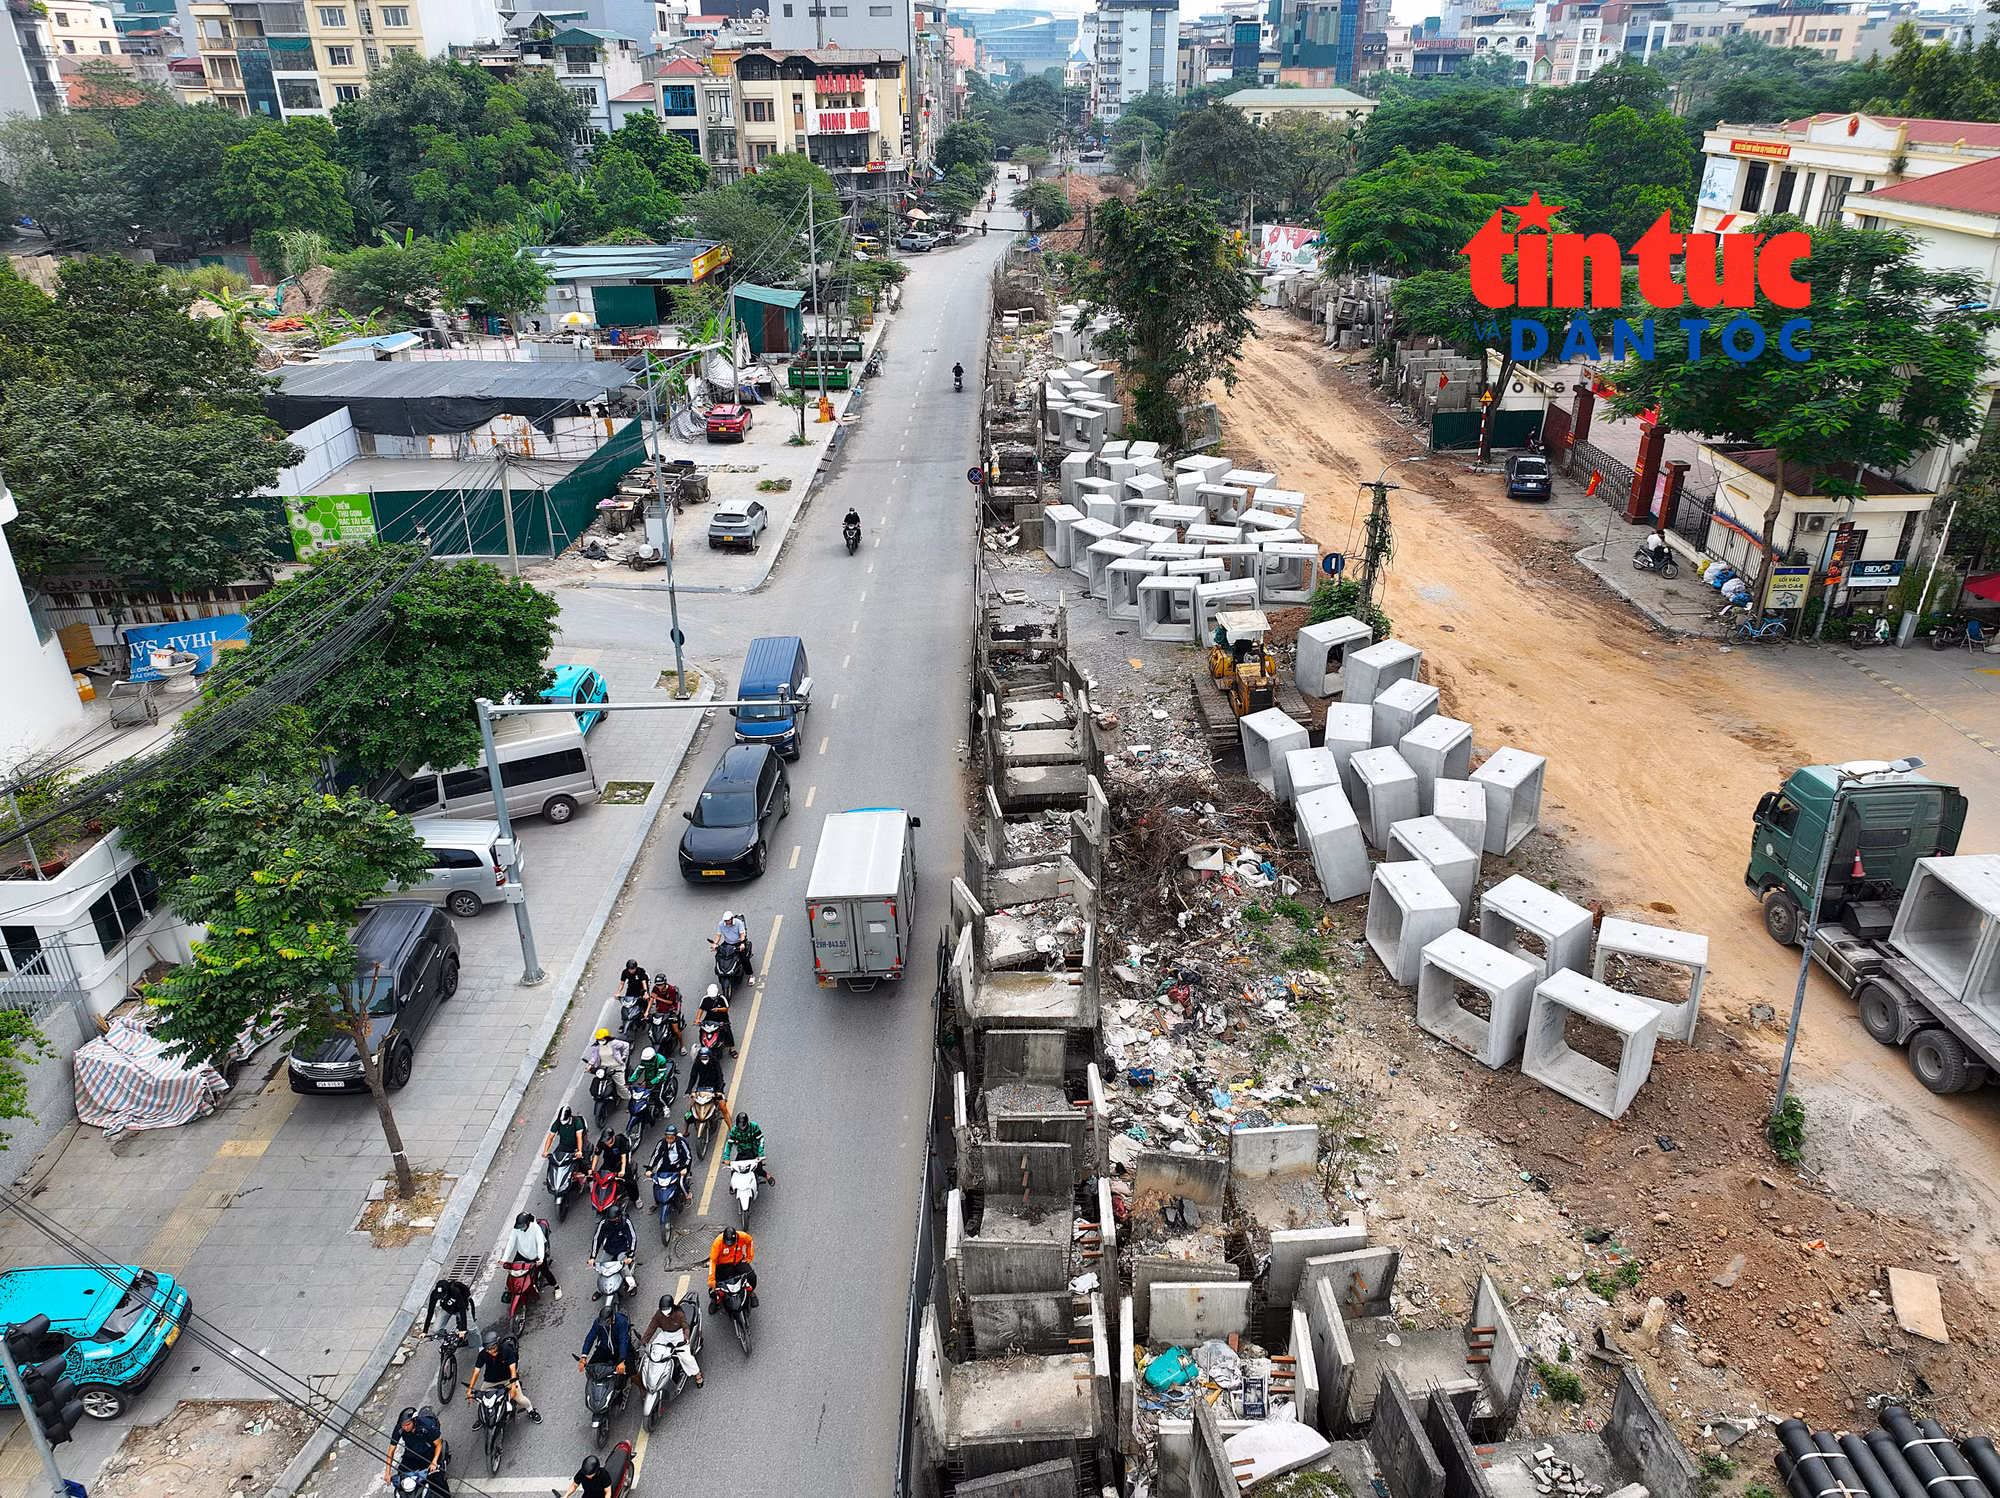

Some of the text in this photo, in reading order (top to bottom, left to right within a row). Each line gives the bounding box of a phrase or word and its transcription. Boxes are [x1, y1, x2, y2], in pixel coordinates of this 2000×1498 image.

[819, 109, 869, 130] NINH BÌNH
[816, 940, 847, 948] 29H-843.55
